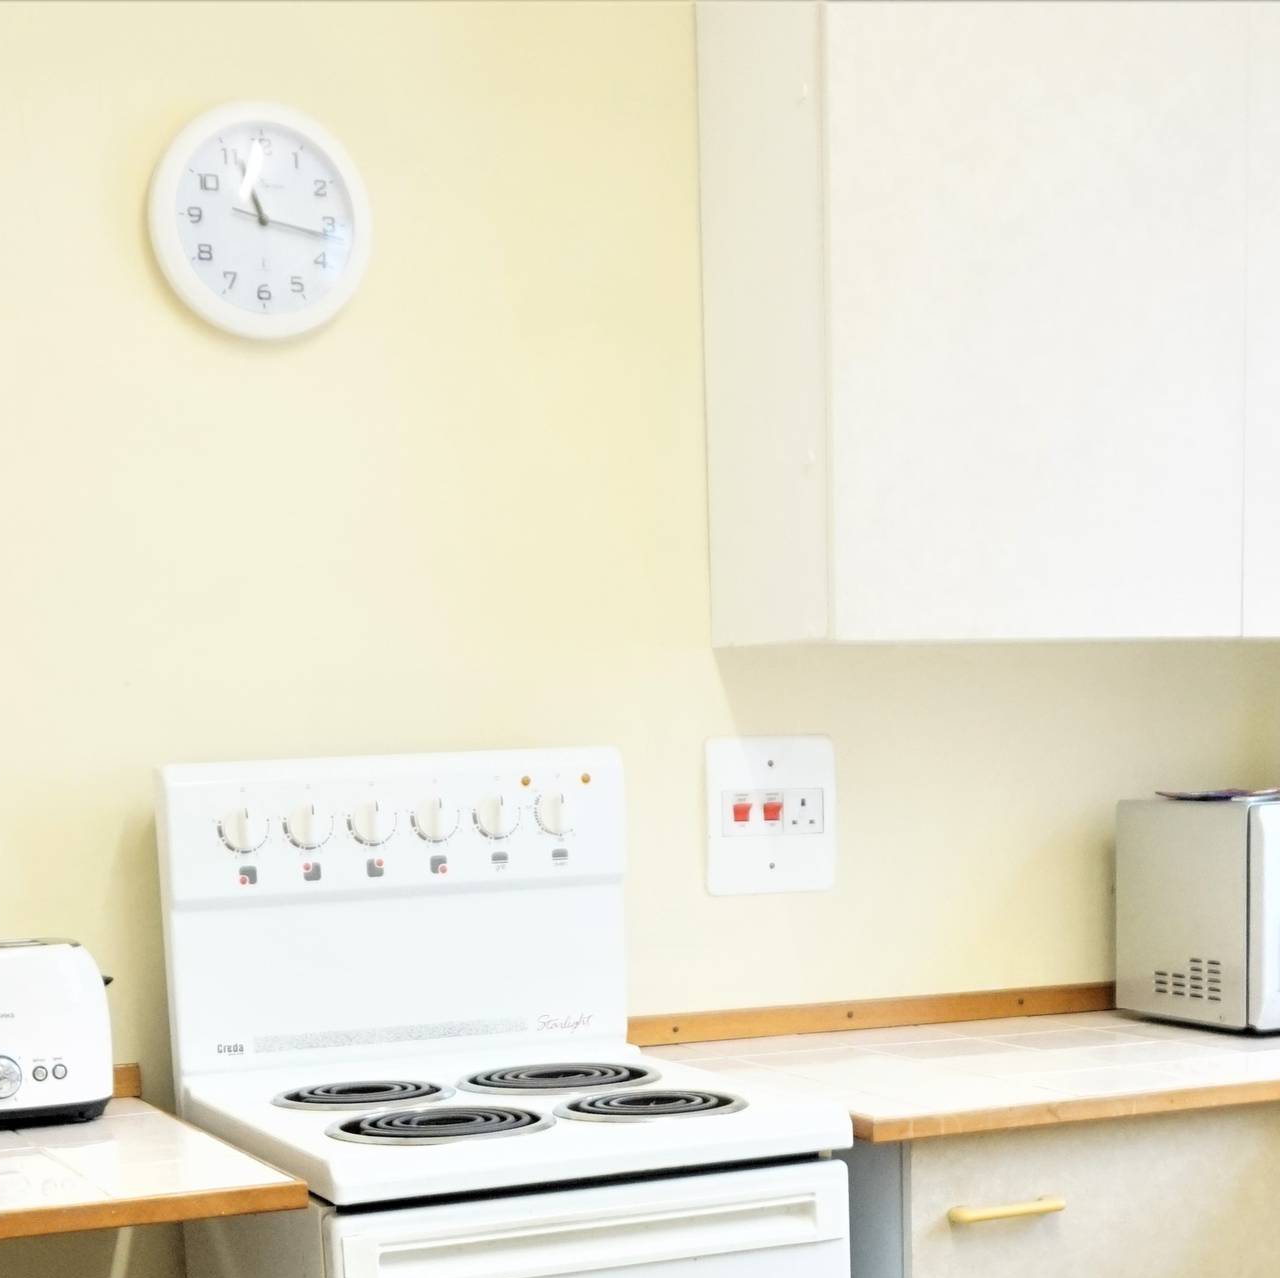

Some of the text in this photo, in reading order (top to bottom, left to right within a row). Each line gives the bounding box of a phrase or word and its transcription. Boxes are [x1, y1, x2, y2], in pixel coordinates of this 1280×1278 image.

[291, 151, 299, 169] 1
[198, 173, 219, 191] 10
[313, 179, 327, 197] 2
[187, 206, 202, 224] 9
[322, 216, 336, 234] 3
[197, 243, 213, 261] 8
[314, 251, 327, 269] 4
[223, 271, 237, 289] 7
[290, 276, 304, 293] 5
[257, 283, 271, 301] 6
[217, 1043, 245, 1054] Creda
